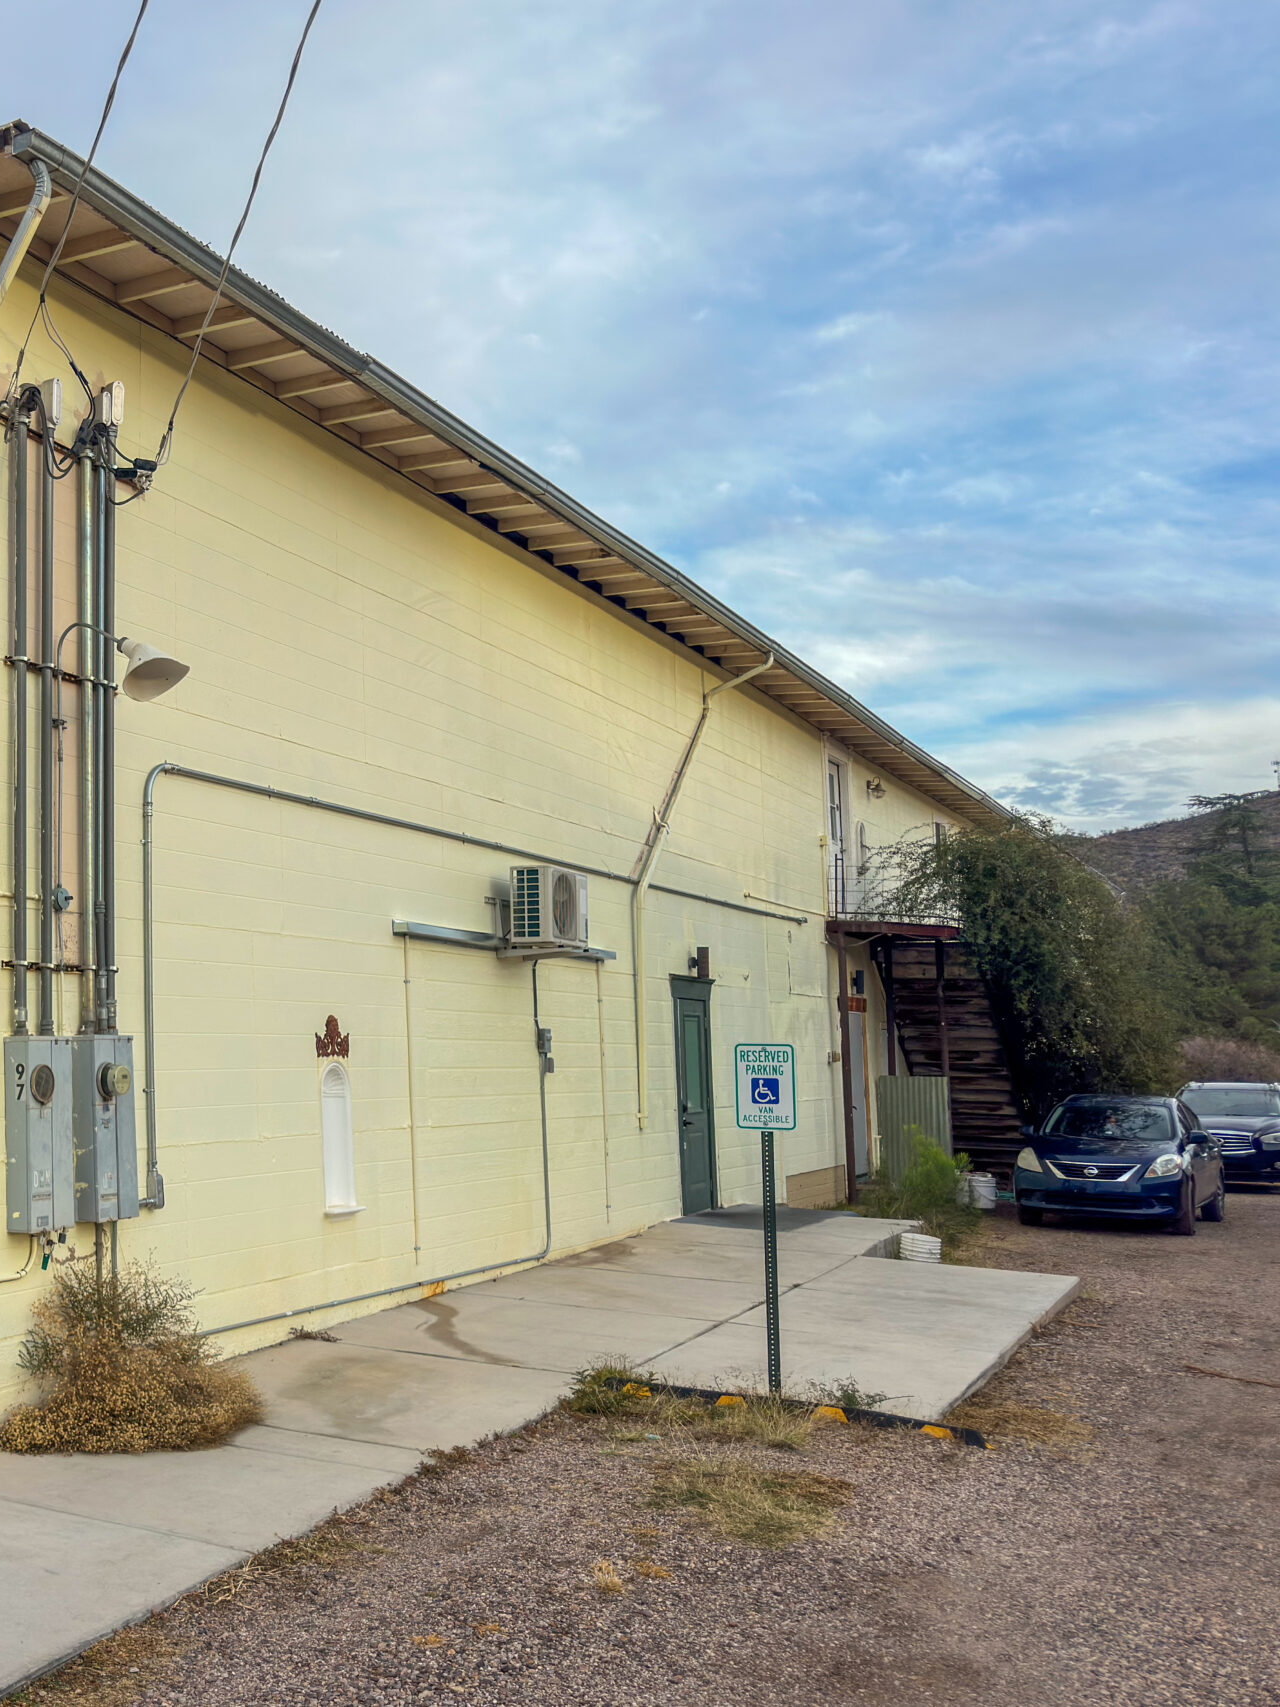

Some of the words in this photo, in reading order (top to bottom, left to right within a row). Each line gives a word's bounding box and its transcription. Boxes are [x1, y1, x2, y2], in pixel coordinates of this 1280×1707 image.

[739, 1050, 789, 1063] RESERVED
[745, 1064, 784, 1076] PARKING
[758, 1106, 774, 1114] VAN
[742, 1114, 790, 1123] ACCESSIBLE
